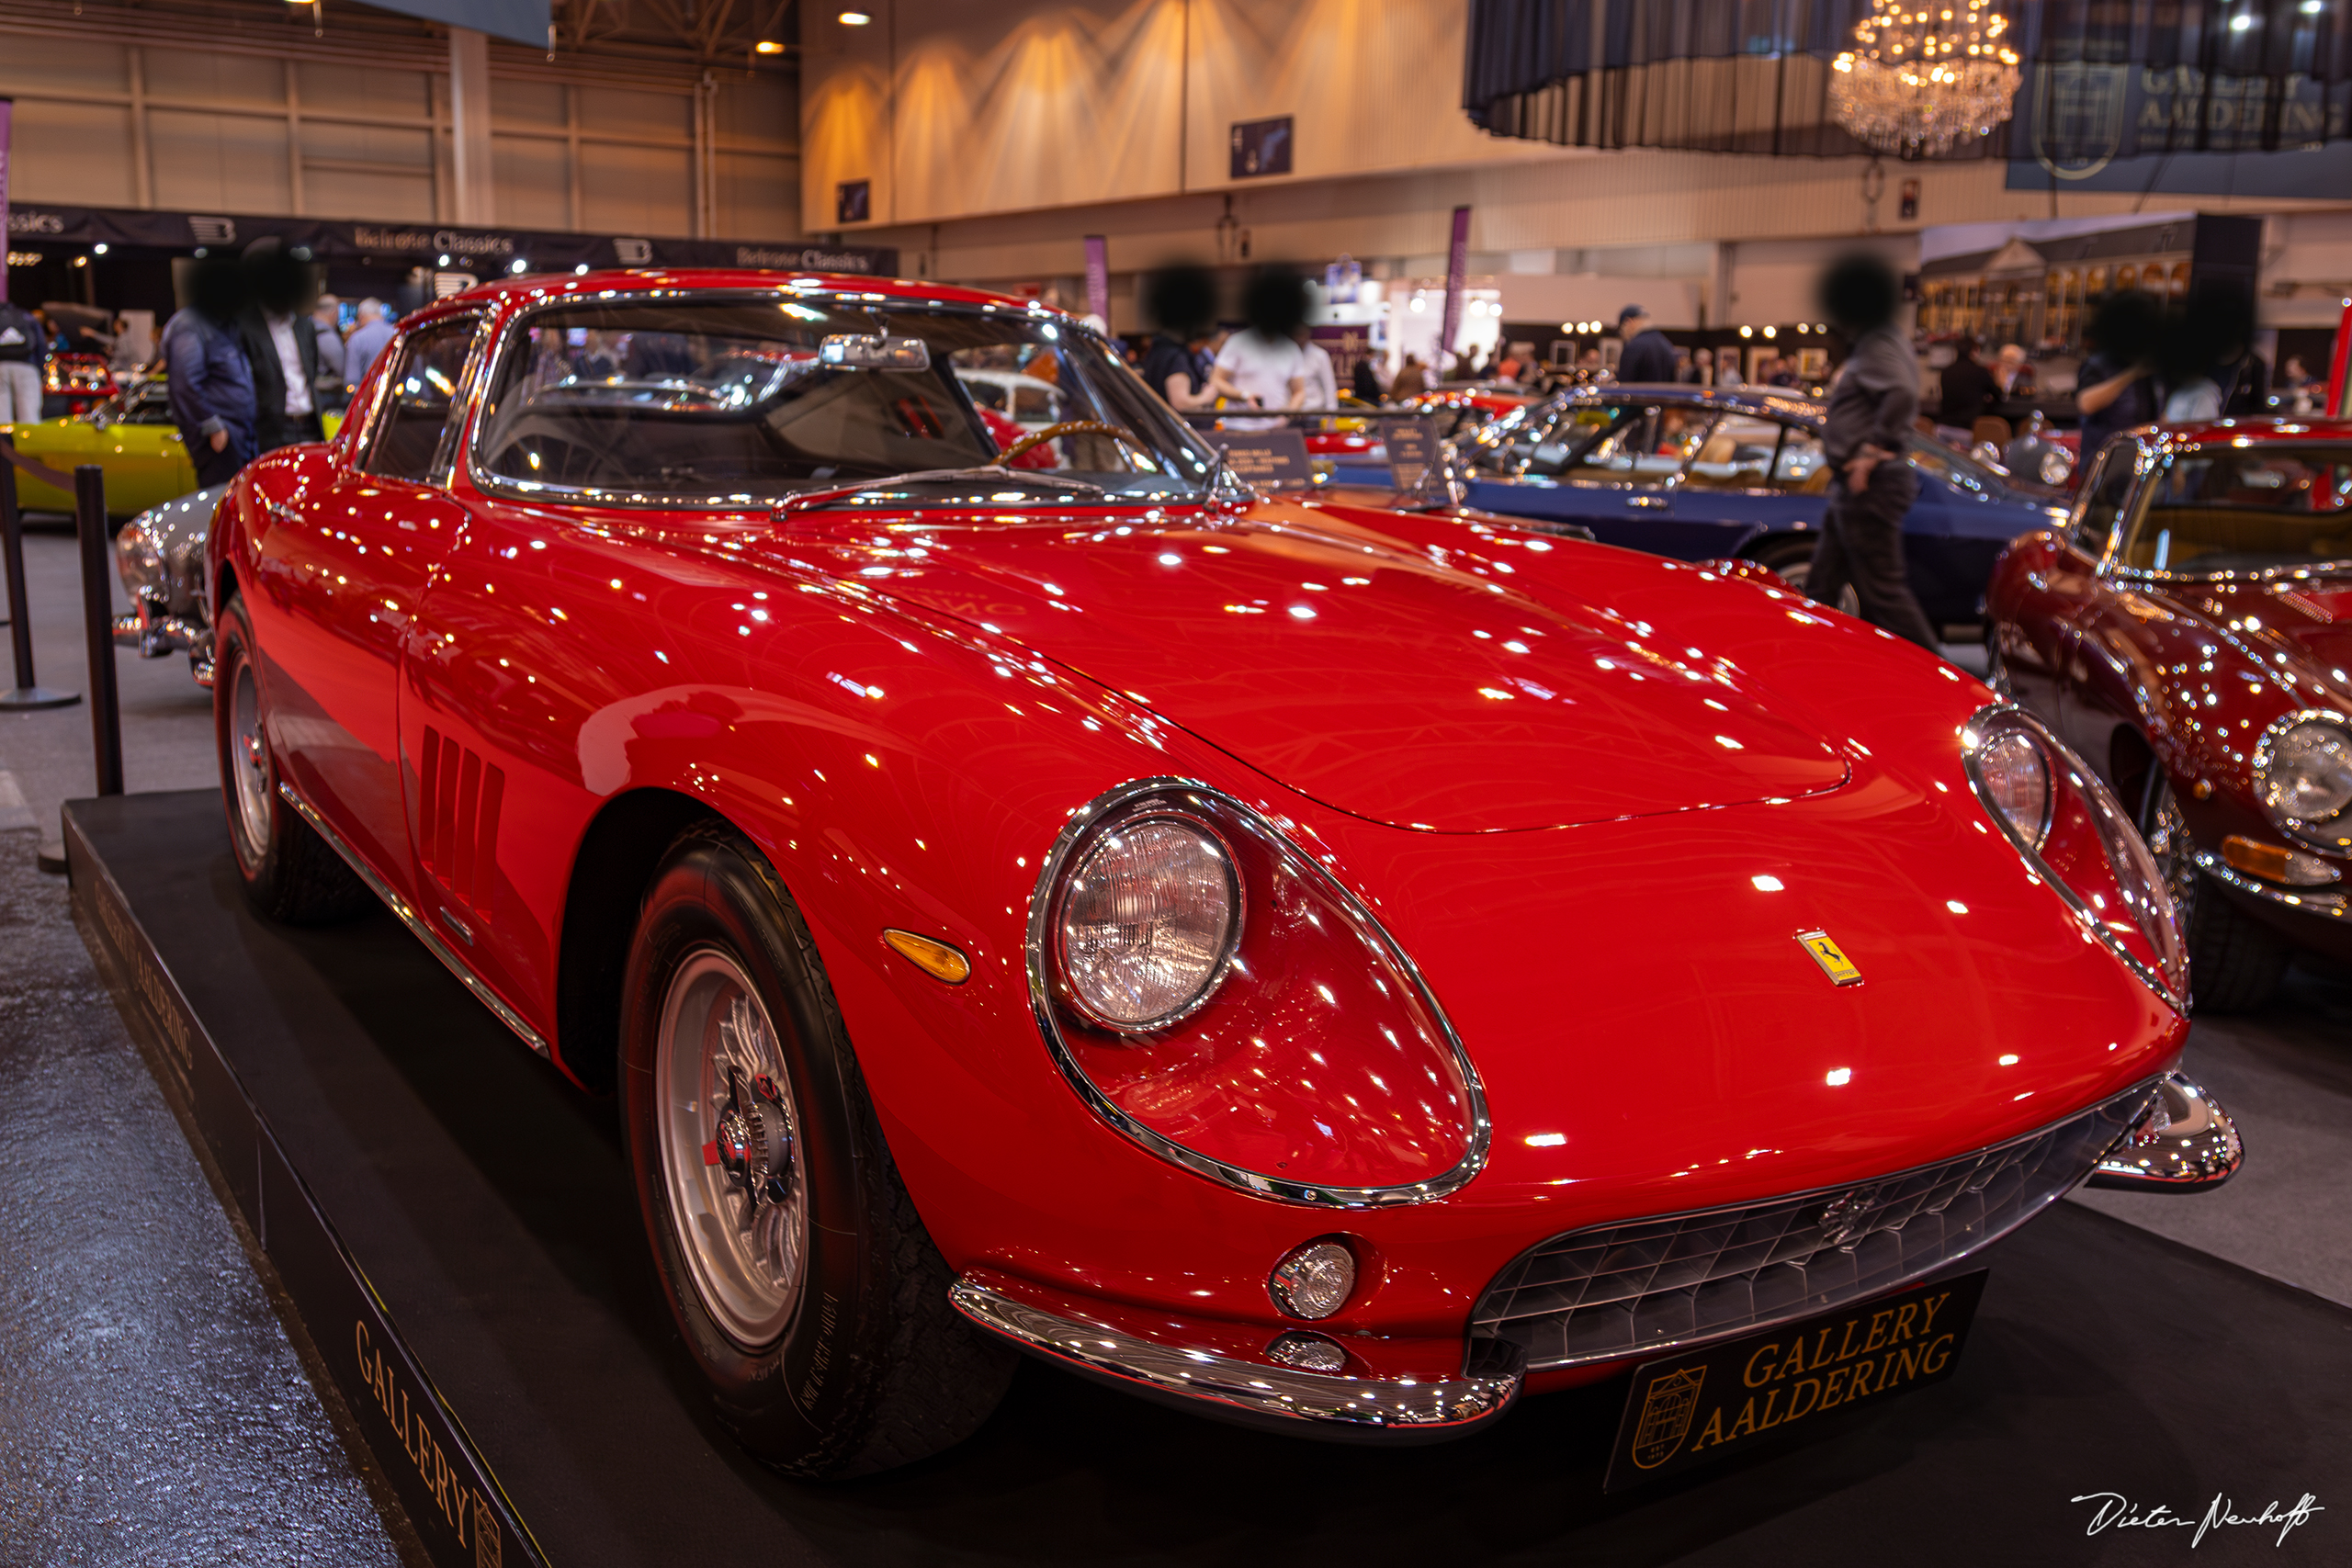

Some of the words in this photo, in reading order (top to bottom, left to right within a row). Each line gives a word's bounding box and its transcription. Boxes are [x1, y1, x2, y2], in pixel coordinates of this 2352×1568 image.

[2141, 64, 2310, 99] GALEY
[2137, 97, 2346, 136] AALDEING
[7, 211, 64, 233] ssics
[433, 230, 514, 255] Classics
[1743, 1292, 1951, 1389] GALLERY
[1690, 1333, 1954, 1452] AALDERING
[356, 1319, 469, 1550] GALLERY
